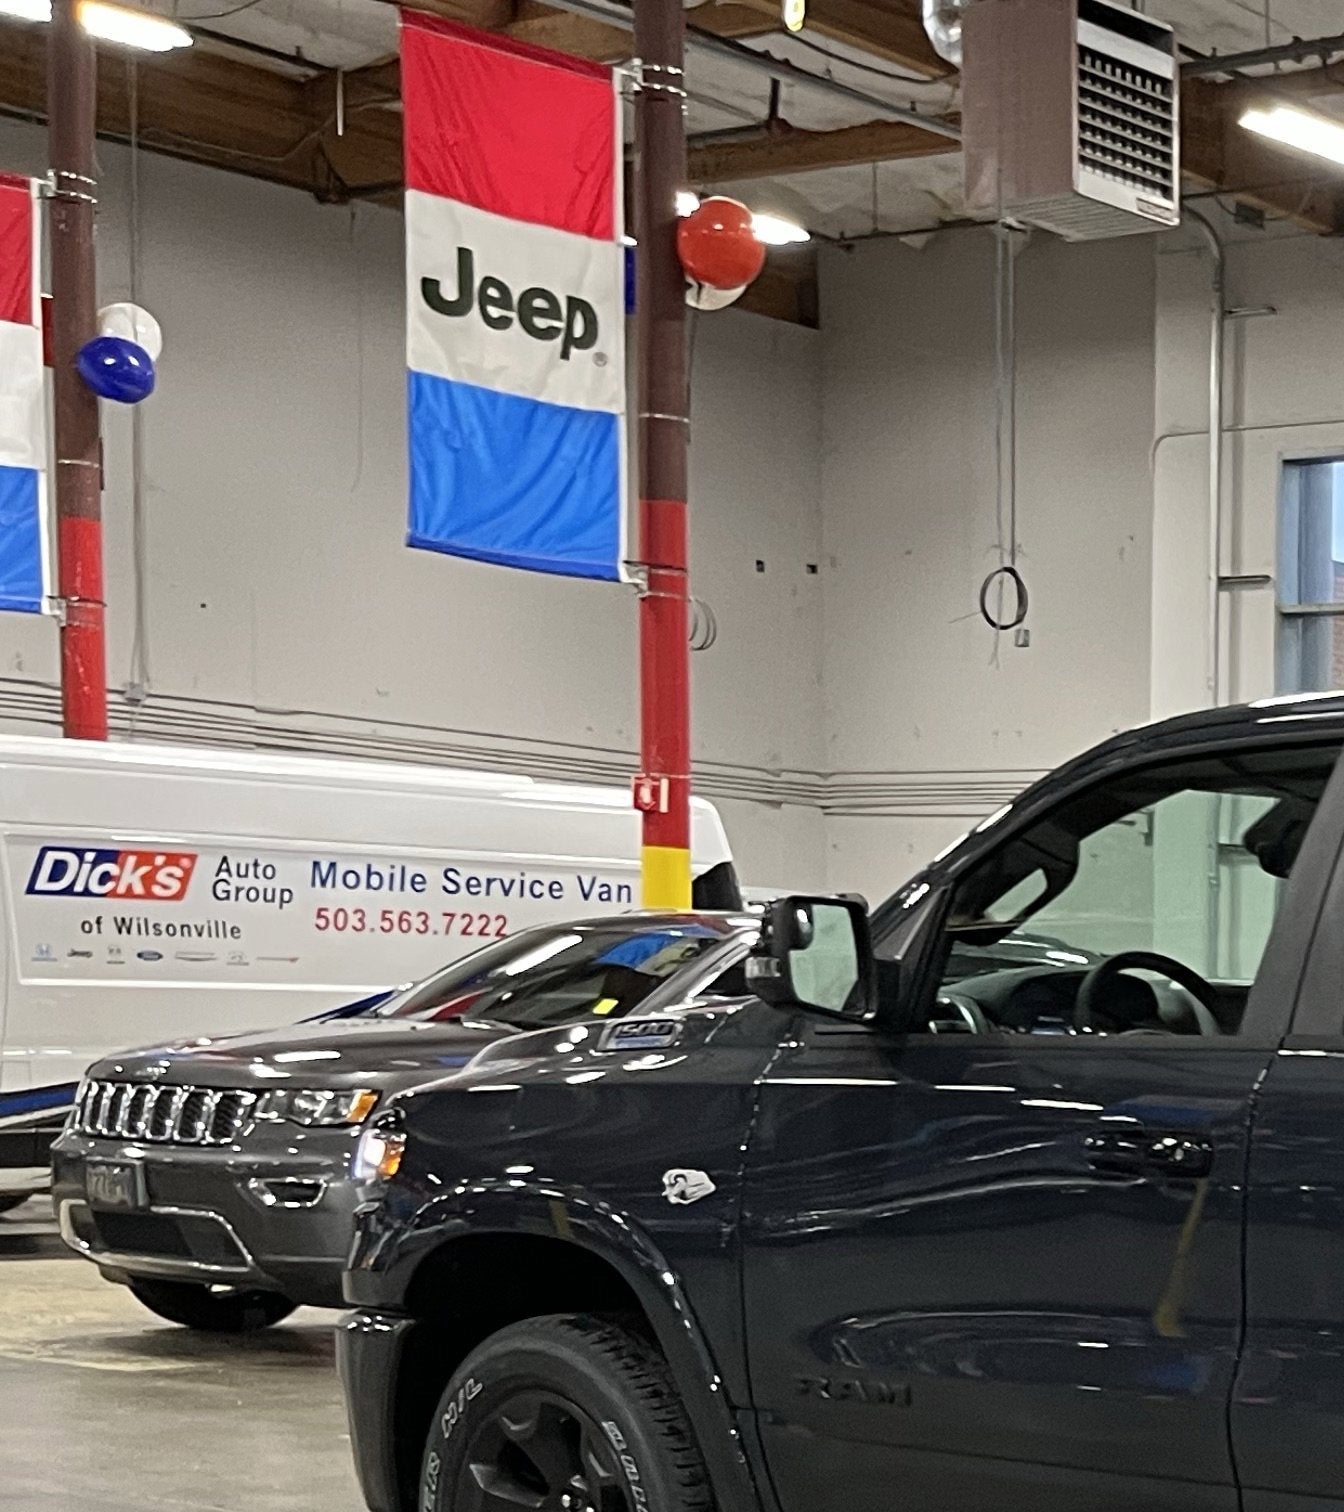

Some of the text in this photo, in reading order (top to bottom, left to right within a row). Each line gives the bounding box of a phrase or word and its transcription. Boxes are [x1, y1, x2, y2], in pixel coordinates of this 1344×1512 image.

[421, 246, 598, 361] Jeep
[215, 855, 277, 880] Auto
[310, 861, 632, 903] Mobile Service Van
[212, 879, 294, 909] Group
[81, 916, 242, 940] of Wilsonville
[314, 907, 509, 938] 503.563.7222
